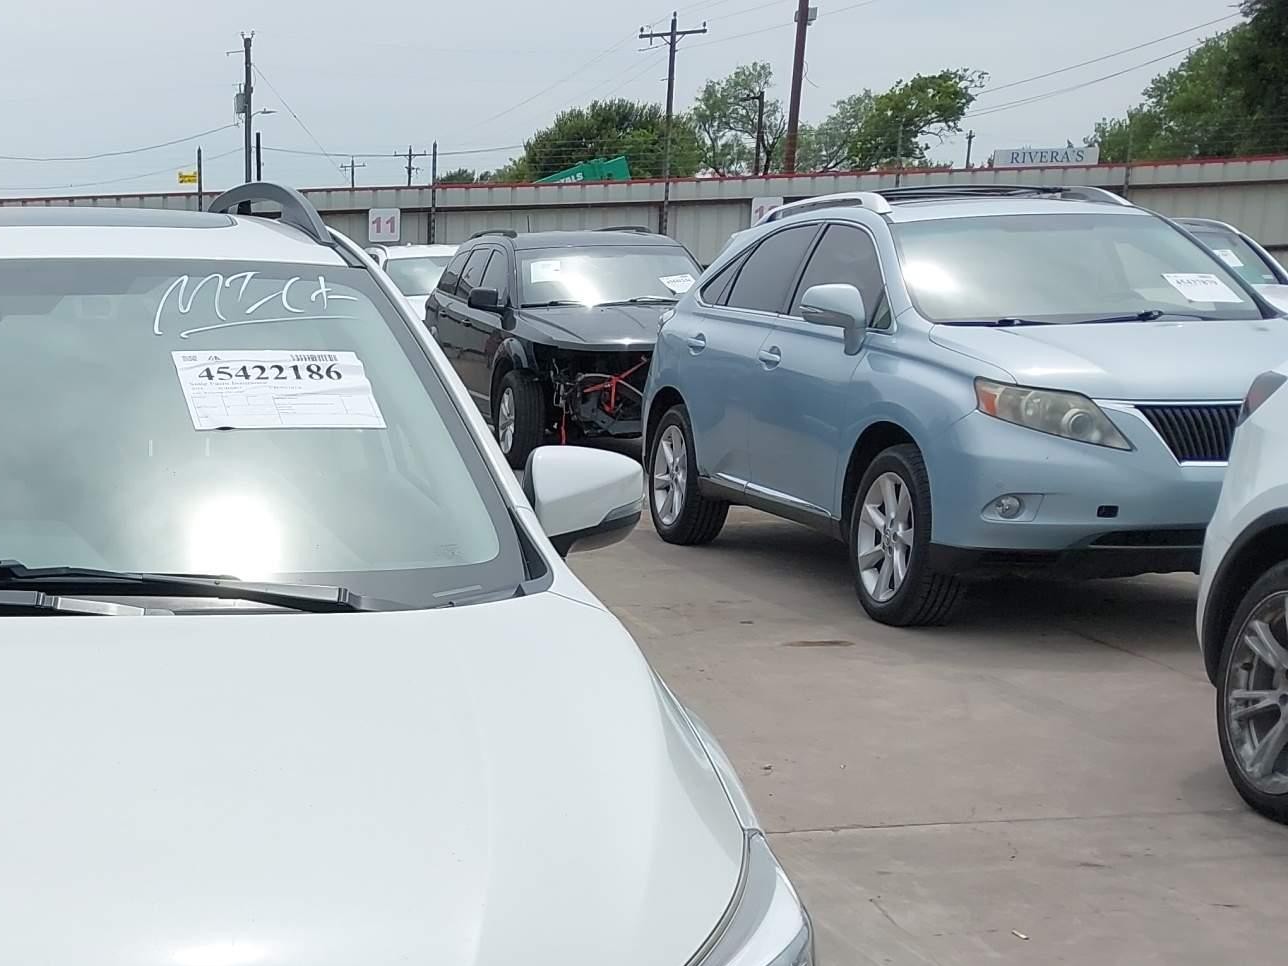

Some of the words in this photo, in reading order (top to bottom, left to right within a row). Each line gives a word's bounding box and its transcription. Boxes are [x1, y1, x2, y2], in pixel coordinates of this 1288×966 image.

[1010, 149, 1085, 164] RIVERA'S
[372, 216, 396, 234] 11
[197, 363, 343, 381] 45422186
